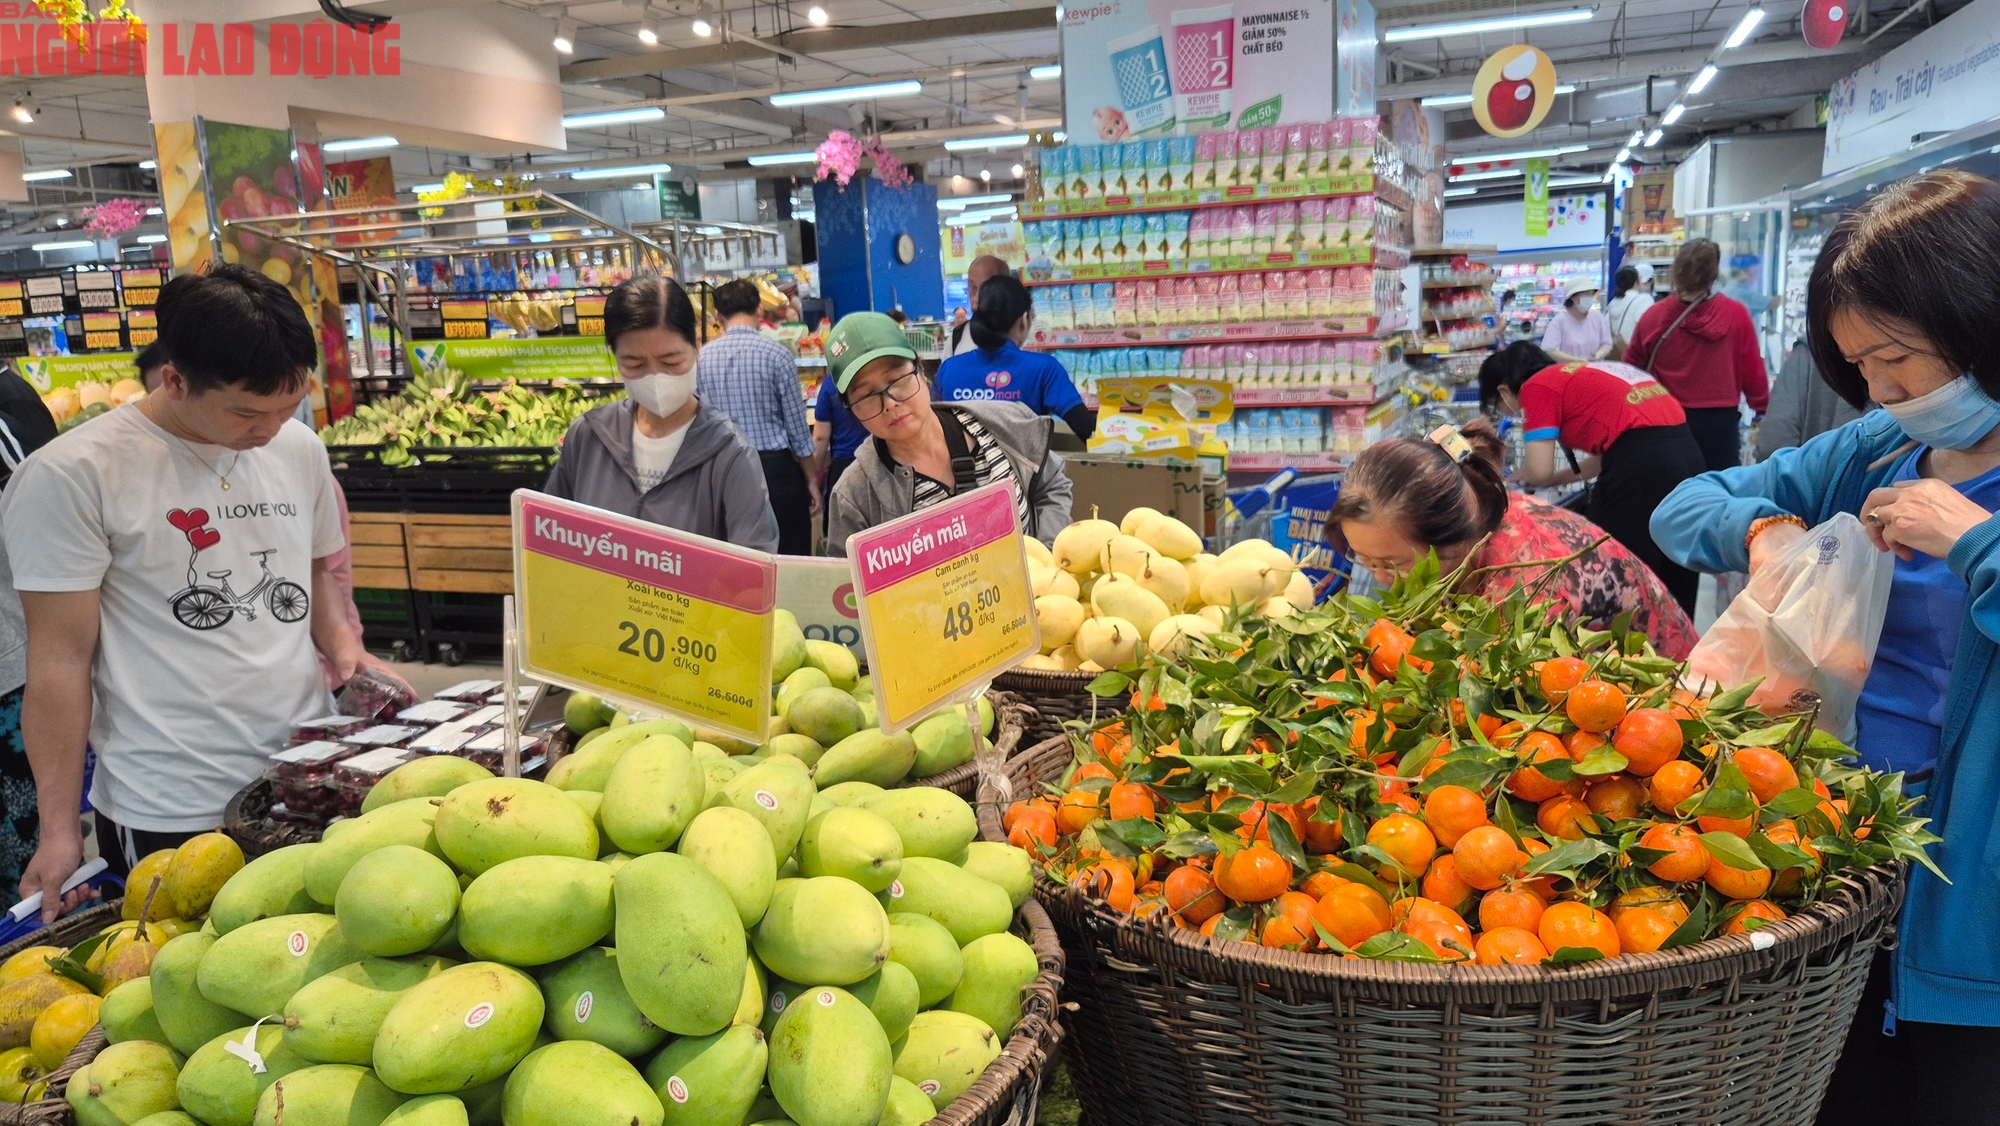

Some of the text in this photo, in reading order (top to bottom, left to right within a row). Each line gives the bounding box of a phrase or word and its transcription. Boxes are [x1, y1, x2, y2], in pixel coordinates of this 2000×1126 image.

[1064, 3, 1112, 21] kewpie
[1241, 10, 1299, 27] MAYONNAISE
[1241, 26, 1287, 41] GIẢM 50%
[1241, 40, 1283, 56] CHẤT BÉO
[1868, 87, 1888, 117] Rau
[1895, 67, 1915, 105] Trái
[1914, 59, 1937, 99] cây
[1187, 93, 1221, 106] KEWPIE
[1135, 103, 1165, 119] KEWPIE
[1445, 227, 1474, 239] Meat
[217, 502, 298, 519] I LOVE YOU
[534, 515, 683, 577] Khuyến mãi
[866, 515, 968, 575] Khuyến mãi
[935, 553, 980, 578] Cam canh kg
[626, 579, 690, 608] Xoài keo kg
[628, 596, 641, 605] Sản
[642, 600, 660, 611] phẩm
[671, 608, 685, 618] toàn
[656, 611, 669, 621] Việt
[670, 615, 685, 625] Nam
[943, 601, 974, 642] 48
[978, 611, 996, 627] đ/kg
[618, 620, 665, 663] 20
[673, 656, 701, 676] đ/kg
